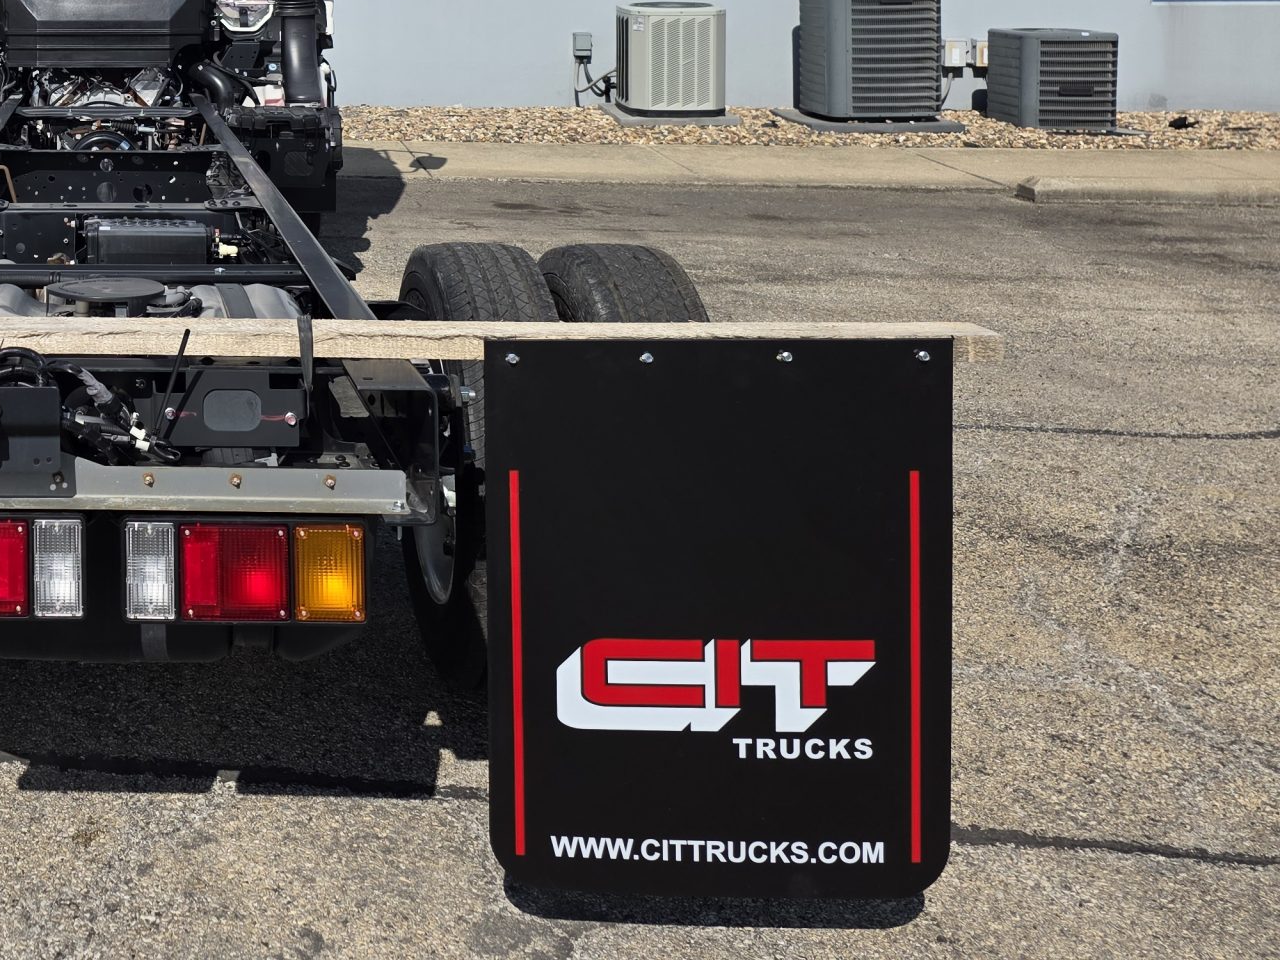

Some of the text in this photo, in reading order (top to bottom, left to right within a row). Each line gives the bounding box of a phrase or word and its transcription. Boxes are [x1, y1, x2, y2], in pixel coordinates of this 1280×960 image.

[556, 638, 877, 732] CIT
[732, 737, 874, 760] TRUCKS
[550, 834, 886, 864] WWW.CITTRUCKS.COM
